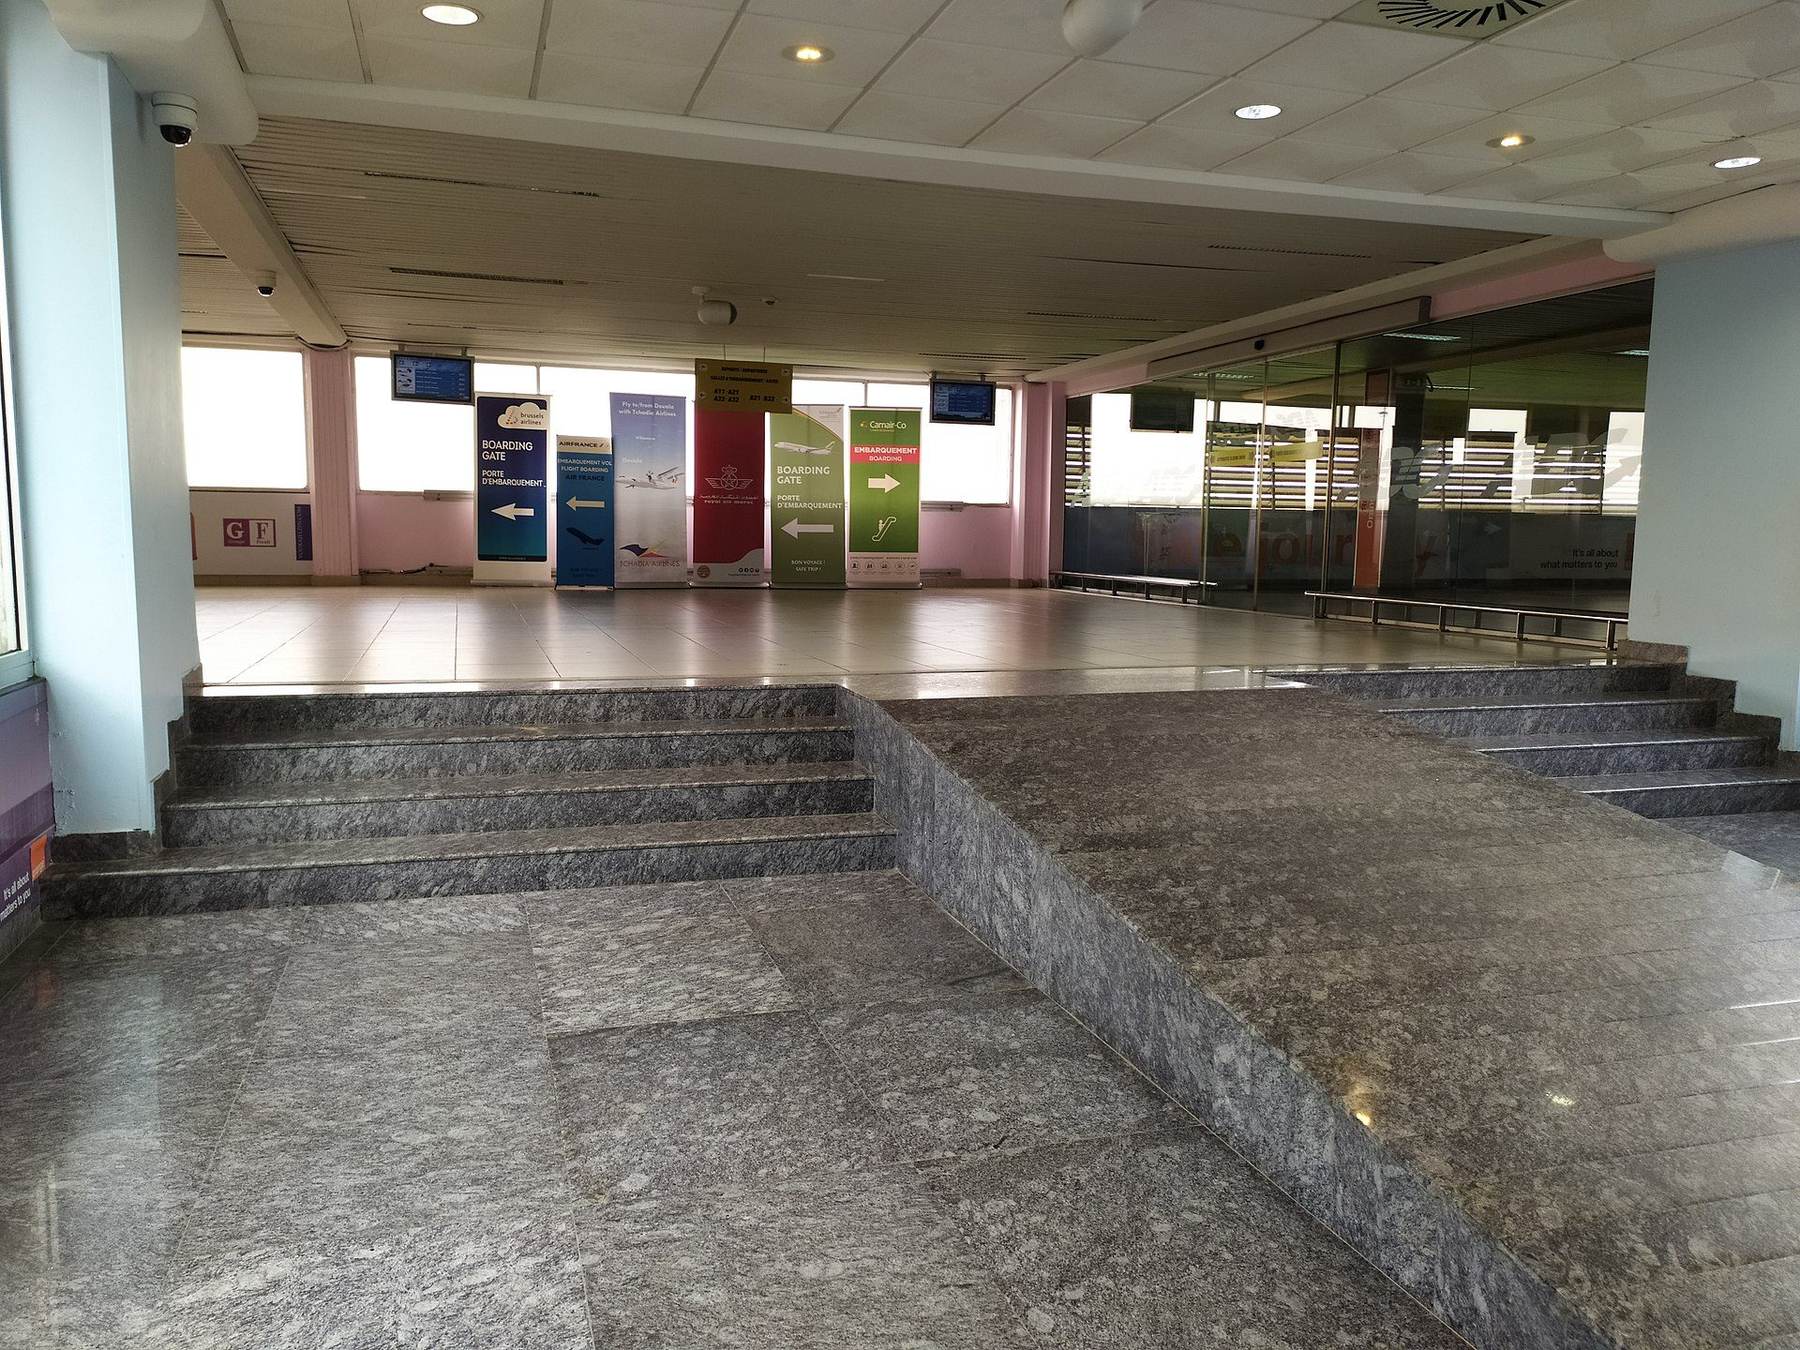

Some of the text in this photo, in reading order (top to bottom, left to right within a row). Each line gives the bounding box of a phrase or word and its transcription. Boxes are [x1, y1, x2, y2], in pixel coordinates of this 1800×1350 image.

[870, 421, 907, 429] Camair-Co
[482, 440, 533, 451] BOARDING
[482, 451, 506, 461] GATE
[777, 466, 830, 475] BOARDING
[777, 476, 802, 484] GATE
[777, 502, 842, 510] D'EMBARQUEMENT
[226, 522, 279, 539] G F
[1596, 549, 1619, 557] about
[1540, 560, 1560, 569] what
[1562, 560, 1592, 569] matters
[1595, 560, 1602, 568] to
[3, 887, 11, 901] It's
[17, 872, 29, 889] about
[23, 888, 31, 903] you
